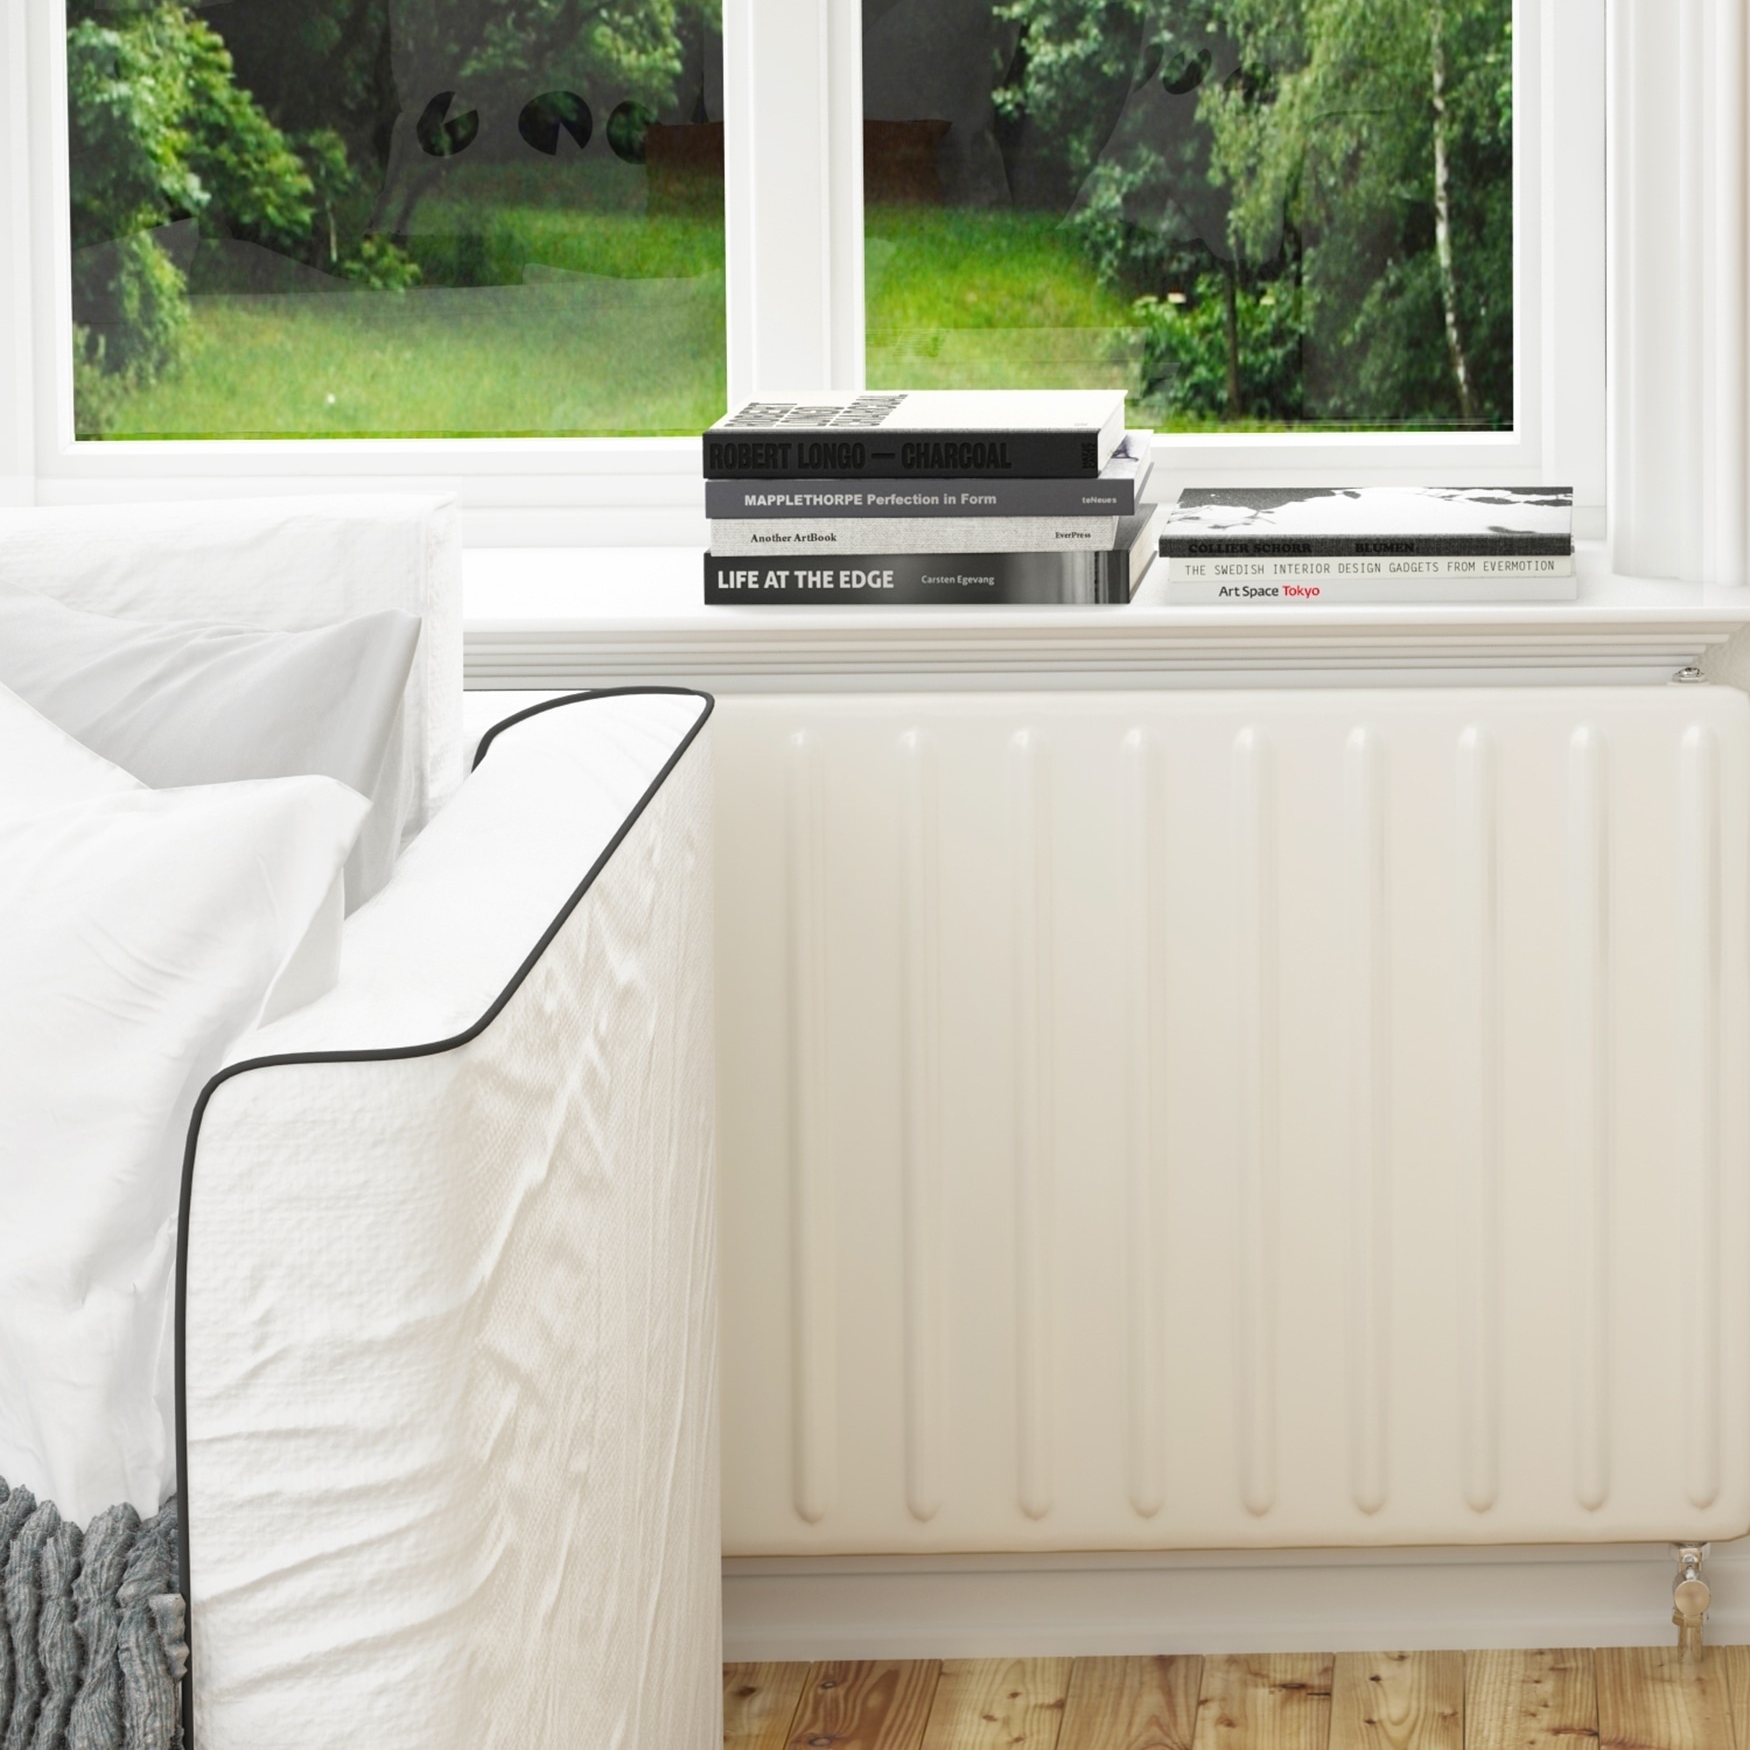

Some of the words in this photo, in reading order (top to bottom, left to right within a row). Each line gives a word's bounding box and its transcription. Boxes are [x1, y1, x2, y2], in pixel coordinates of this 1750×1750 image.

[709, 442, 792, 470] ROBERT
[798, 442, 866, 470] LONGO
[901, 442, 1012, 470] CHARCOAL
[744, 494, 863, 506] MAPPLETHORPE
[867, 494, 939, 506] Perfection
[943, 494, 956, 505] in
[960, 493, 997, 505] Form
[1081, 496, 1117, 505] teNeues
[750, 533, 792, 543] Another
[794, 532, 837, 543] ArtBook
[1055, 530, 1091, 539] EverPress
[1188, 543, 1250, 554] COLLIER
[1253, 543, 1313, 553] SCHORR
[1355, 542, 1415, 553] BLUMEN
[1185, 565, 1206, 576] THE
[1214, 564, 1265, 576] SWEDISH
[1273, 563, 1331, 575] INTERIOR
[1338, 562, 1381, 574] DESIGN
[1388, 561, 1439, 573] GADGETS
[1447, 561, 1476, 572] FROM
[1483, 560, 1555, 572] EVERMOTION
[717, 570, 760, 589] LIFE
[763, 570, 790, 589] AT
[794, 570, 835, 589] THE
[839, 570, 894, 589] EDGE
[921, 574, 956, 585] Carsten
[957, 573, 995, 587] Egevang
[1218, 586, 1241, 598] Art
[1242, 586, 1279, 599] Space
[1282, 585, 1321, 599] Tokyo
